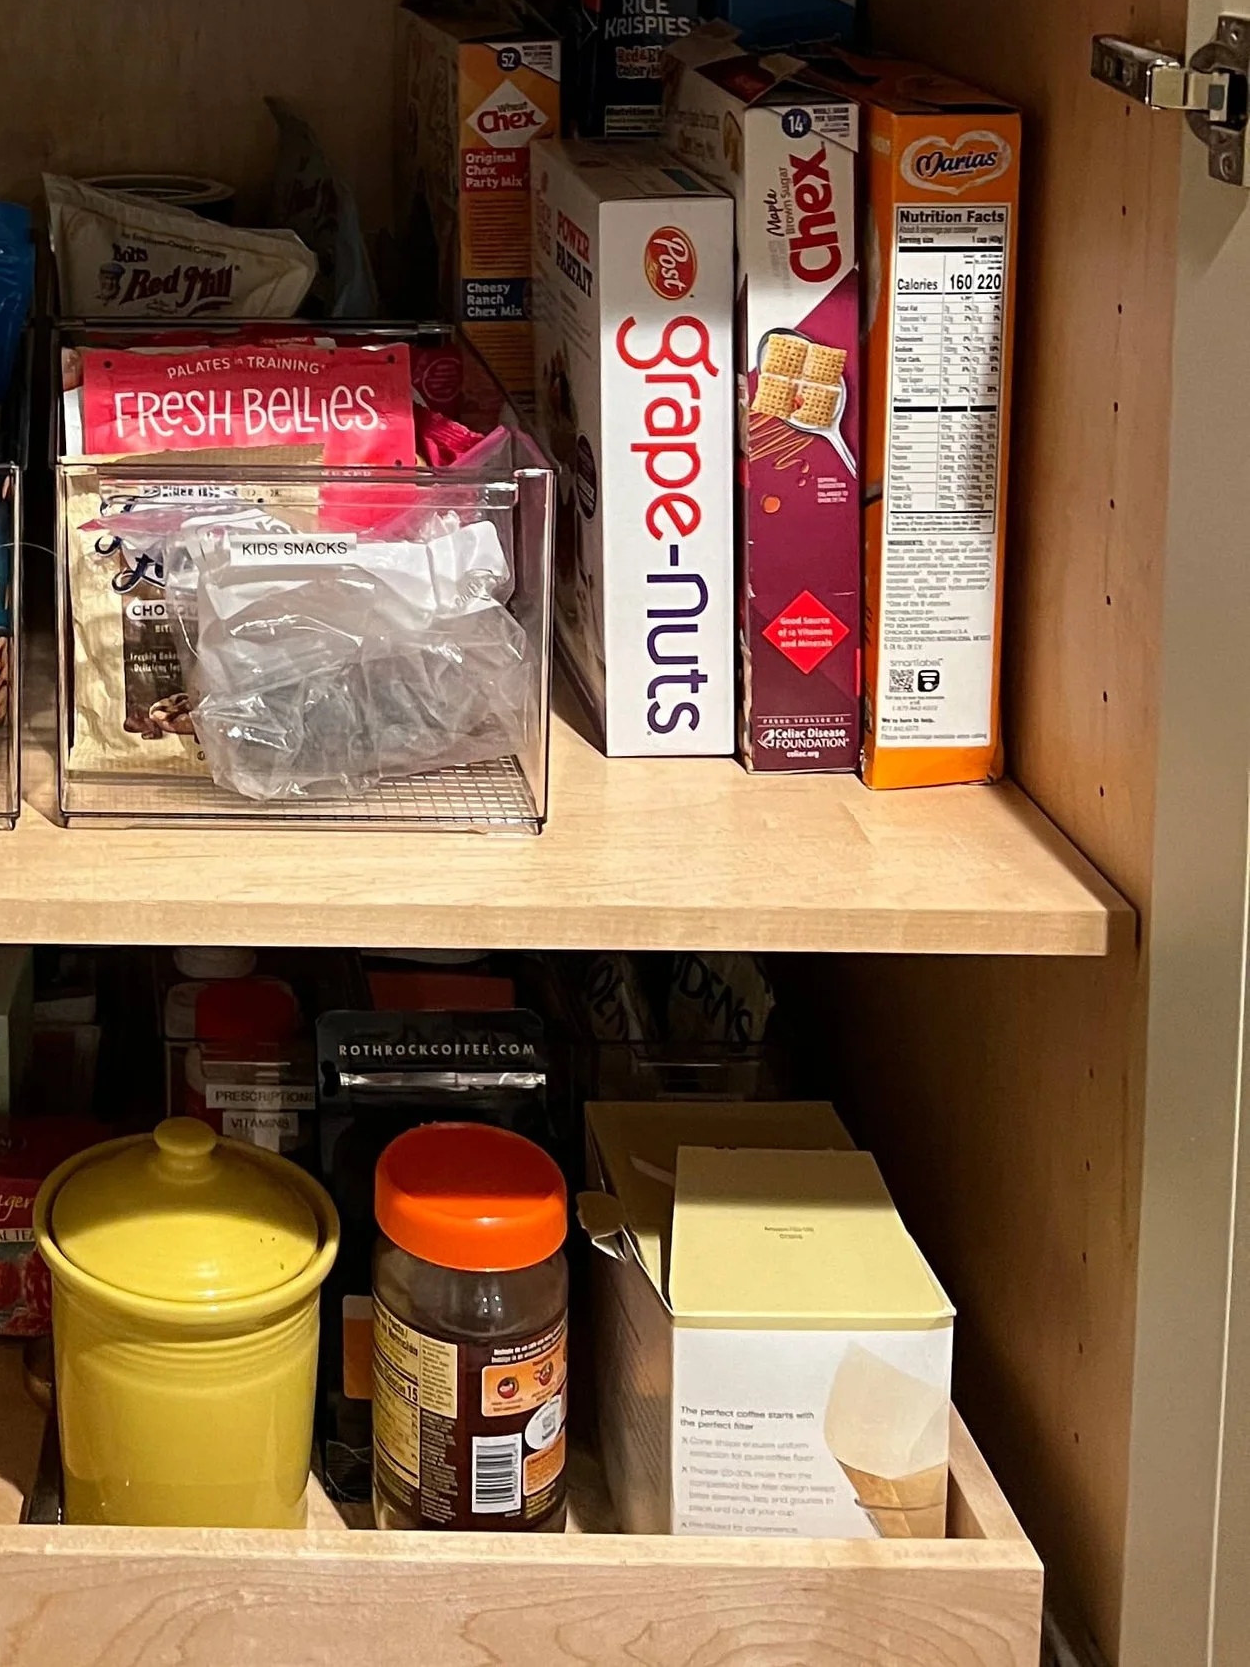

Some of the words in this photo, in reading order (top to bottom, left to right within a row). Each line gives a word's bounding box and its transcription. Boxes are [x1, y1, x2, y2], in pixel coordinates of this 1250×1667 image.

[604, 17, 691, 40] KRISPIES
[501, 53, 515, 67] 52
[477, 109, 542, 133] Chex
[788, 115, 804, 132] 14
[465, 153, 516, 165] Original
[917, 151, 999, 178] Marias
[465, 165, 496, 176] Chex
[465, 177, 498, 189] Party
[501, 176, 522, 187] Mix
[763, 189, 784, 236] Maple
[788, 147, 842, 283] Chex
[900, 211, 961, 223] Nutrition
[966, 210, 1004, 223] Facts
[557, 209, 590, 263] POWER
[556, 240, 593, 299] PARFAIT
[653, 237, 687, 291] Post
[120, 265, 181, 305] Red
[177, 264, 234, 307] Mill
[897, 278, 938, 290] Calories
[950, 274, 972, 290] 160
[978, 273, 1001, 290] 220
[466, 283, 510, 296] Cheesy
[466, 295, 504, 305] Ranch
[467, 306, 496, 317] Chex
[500, 305, 523, 316] Mix
[167, 357, 230, 379] PALATES
[247, 356, 319, 374] TRAINING
[616, 315, 720, 735] grape-nuts
[242, 542, 279, 556] KIDS
[283, 541, 348, 555] SNACKS
[775, 728, 806, 738] Celiac
[807, 728, 845, 738] Disease
[775, 738, 847, 749] FOUNDATION
[339, 1043, 536, 1057] ROTHROCKCOFFEE.COM
[215, 1090, 315, 1103] PRESCRIPTIONS
[231, 1116, 290, 1130] VITAMINS
[680, 1405, 698, 1416] The
[701, 1407, 734, 1420] perfect
[736, 1408, 766, 1420] coffee
[768, 1410, 794, 1420] starts
[796, 1410, 815, 1420] with
[680, 1418, 695, 1428] the
[698, 1420, 732, 1431] perfect
[734, 1421, 754, 1431] filter
